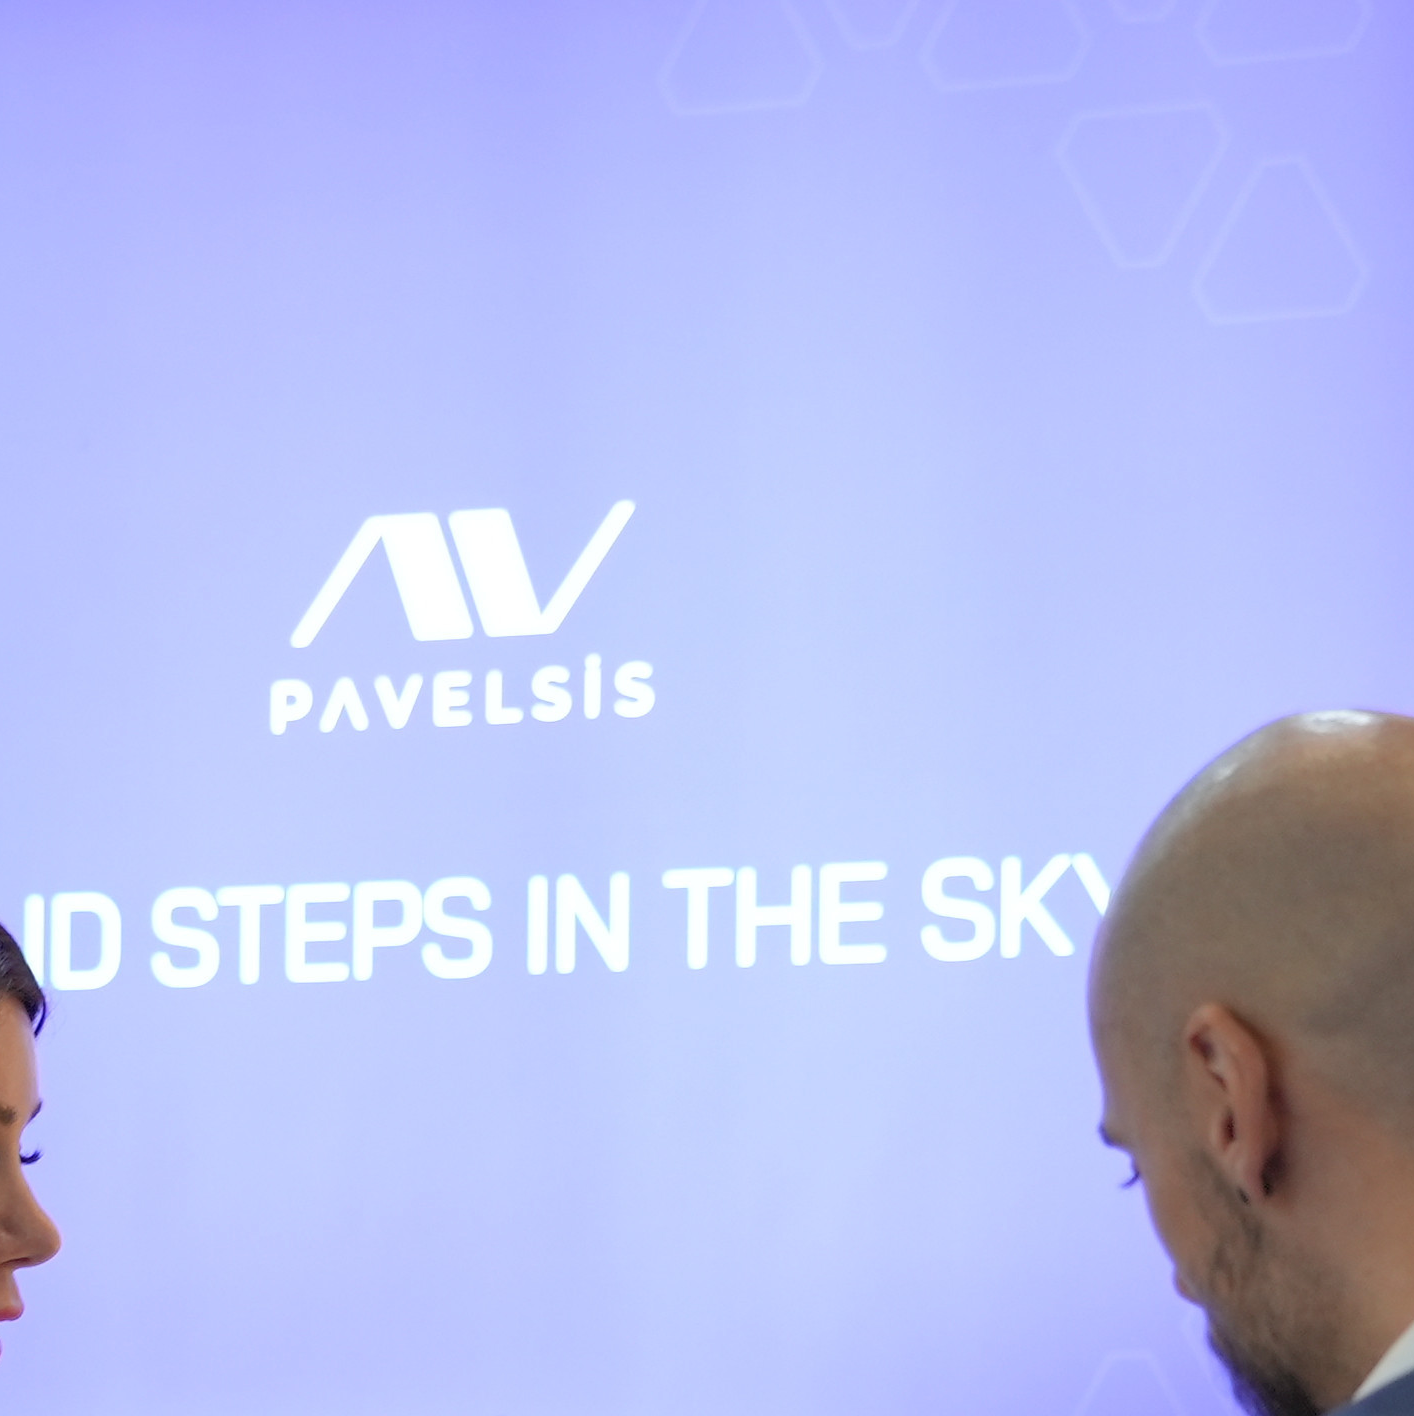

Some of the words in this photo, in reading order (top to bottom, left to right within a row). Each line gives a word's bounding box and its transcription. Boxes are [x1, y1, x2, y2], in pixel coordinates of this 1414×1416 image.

[149, 875, 494, 990] STEPS
[526, 870, 631, 976] IN
[661, 860, 889, 971] THE
